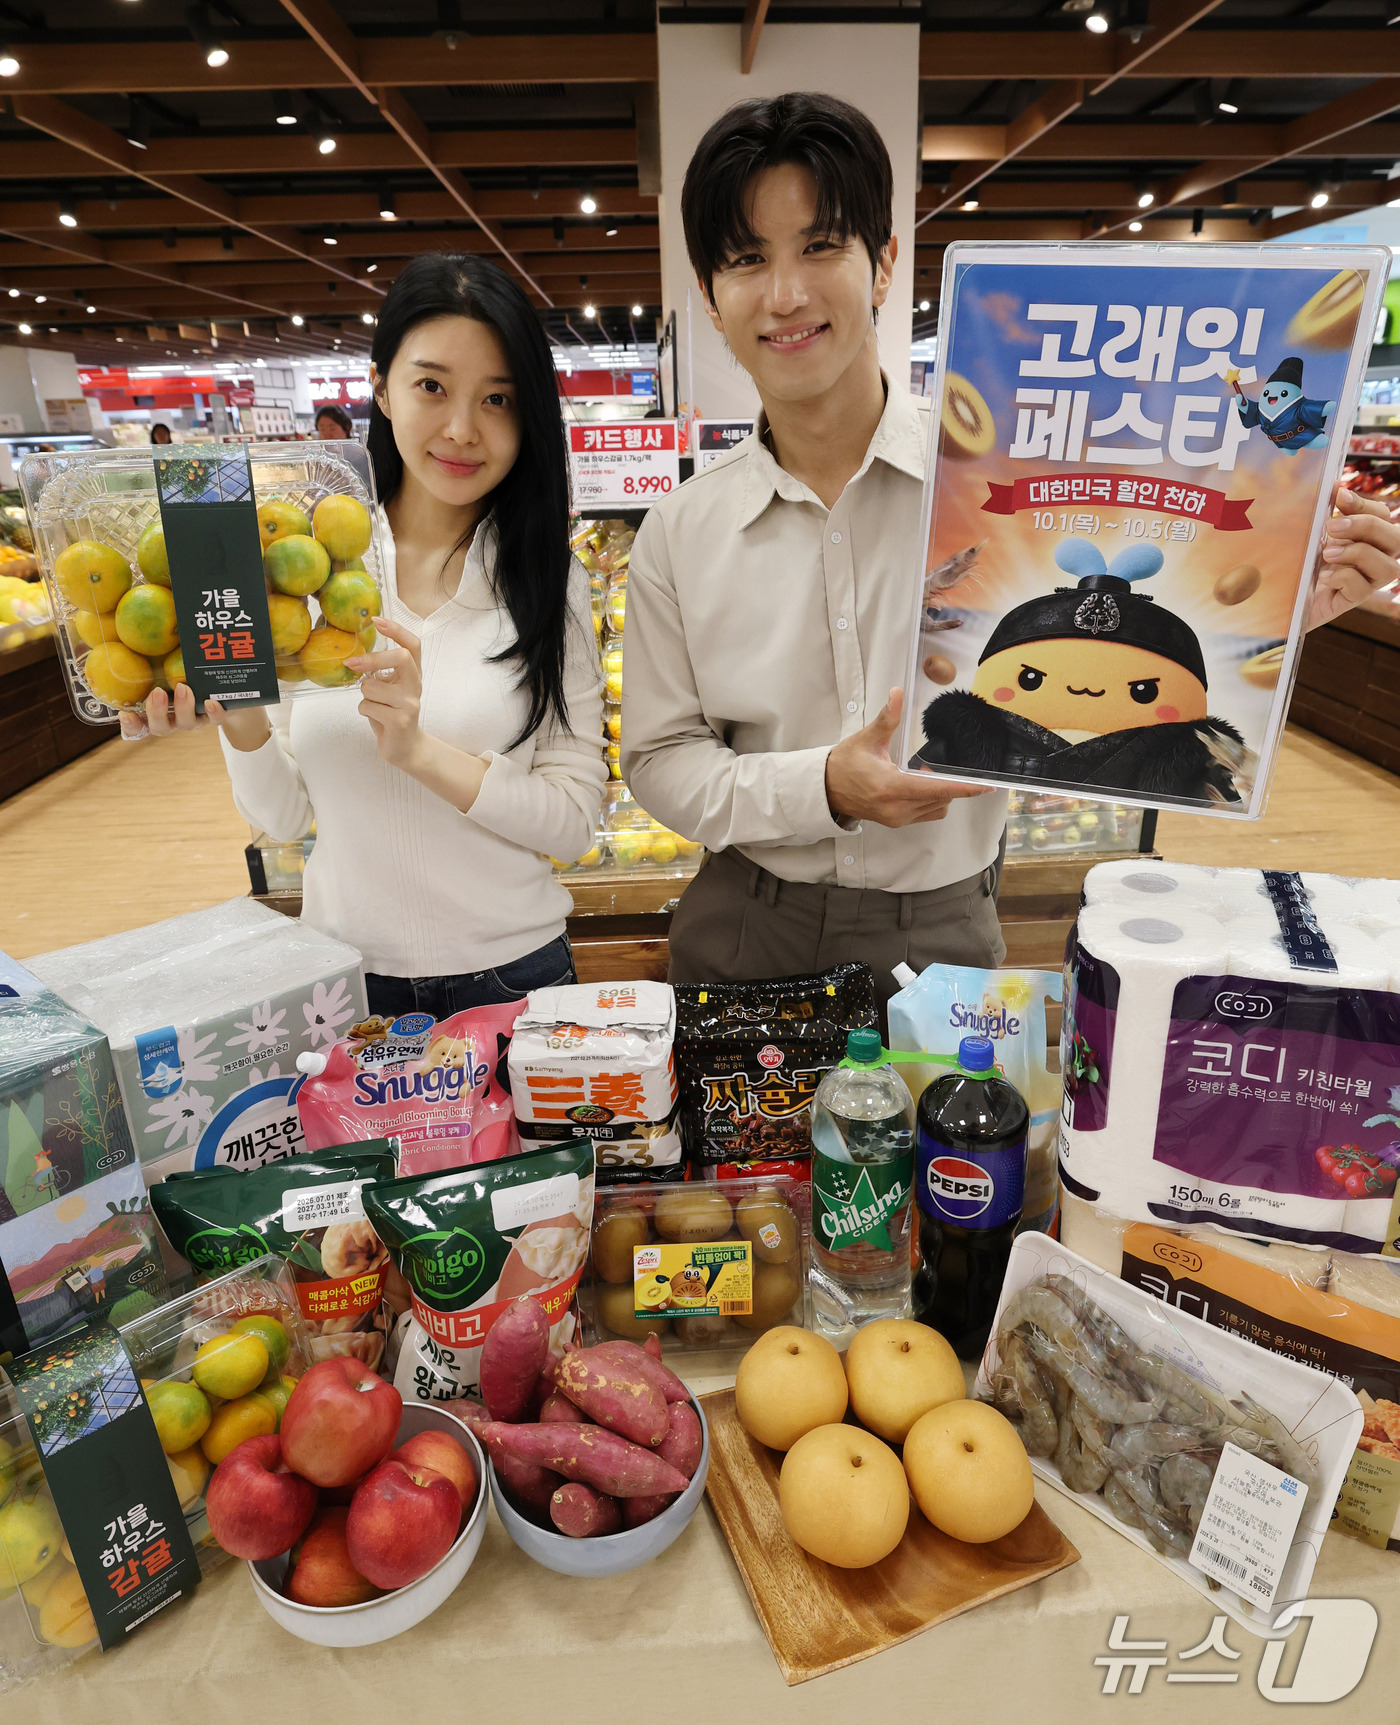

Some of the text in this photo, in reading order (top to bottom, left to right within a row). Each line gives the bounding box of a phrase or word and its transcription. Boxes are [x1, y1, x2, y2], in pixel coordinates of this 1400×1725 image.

[1019, 304, 1265, 385] 고래잇
[584, 428, 663, 449] 카드행사
[1009, 388, 1250, 471] 페스타
[624, 476, 672, 495] 8,990
[1030, 478, 1207, 515] 대한민국 할인 천하
[1032, 512, 1100, 535] 10.1(목)
[1123, 518, 1197, 542] 10.5(월)
[202, 588, 240, 608] 가을
[194, 610, 254, 630] 하우스
[199, 632, 255, 660] 감귤
[1219, 996, 1268, 1016] CODI
[950, 1002, 1020, 1039] Snuggle
[223, 1042, 289, 1073] 깨끗함이 필요한 순간
[361, 1046, 425, 1062] 섬유유연제
[354, 1051, 489, 1106] Snuggle
[383, 1062, 405, 1076] 스너글
[1188, 1040, 1372, 1098] 코디 키친타월
[1187, 1079, 1359, 1115] 강력한 흡수력으로 한번에 쏙!
[365, 1115, 402, 1130] Original
[404, 1108, 448, 1122] Blooming
[223, 1116, 305, 1163] 깨끗한
[572, 1126, 599, 1138] 우지
[401, 1143, 461, 1156] abric Conditioner
[930, 1171, 989, 1198] PEPSI
[1170, 1185, 1214, 1205] 150매
[1218, 1193, 1241, 1208] 6롤
[297, 1194, 334, 1205] 2026.07.01
[297, 1202, 335, 1213] 2027.03.31
[820, 1180, 901, 1238] Chilsung
[319, 1209, 338, 1217] 17:49
[853, 1212, 888, 1238] CIDER
[190, 1244, 263, 1267] bibigo
[695, 1252, 731, 1264] 빈틈없이
[309, 1277, 378, 1301] 매콤아삭 NEW
[309, 1299, 349, 1313] 다채로운
[417, 1303, 485, 1343] 비비고
[1219, 1310, 1248, 1330] 기름기
[1251, 1324, 1271, 1341] 많은
[1274, 1335, 1306, 1354] 음식에
[1310, 1346, 1326, 1361] 딱!
[421, 1335, 461, 1373] 새우
[1283, 1477, 1297, 1489] 신선
[104, 1502, 149, 1542] 가을
[99, 1519, 166, 1568] 하우스
[107, 1538, 172, 1598] 감귤
[1263, 1566, 1273, 1576] 473
[1248, 1579, 1271, 1598] 18825
